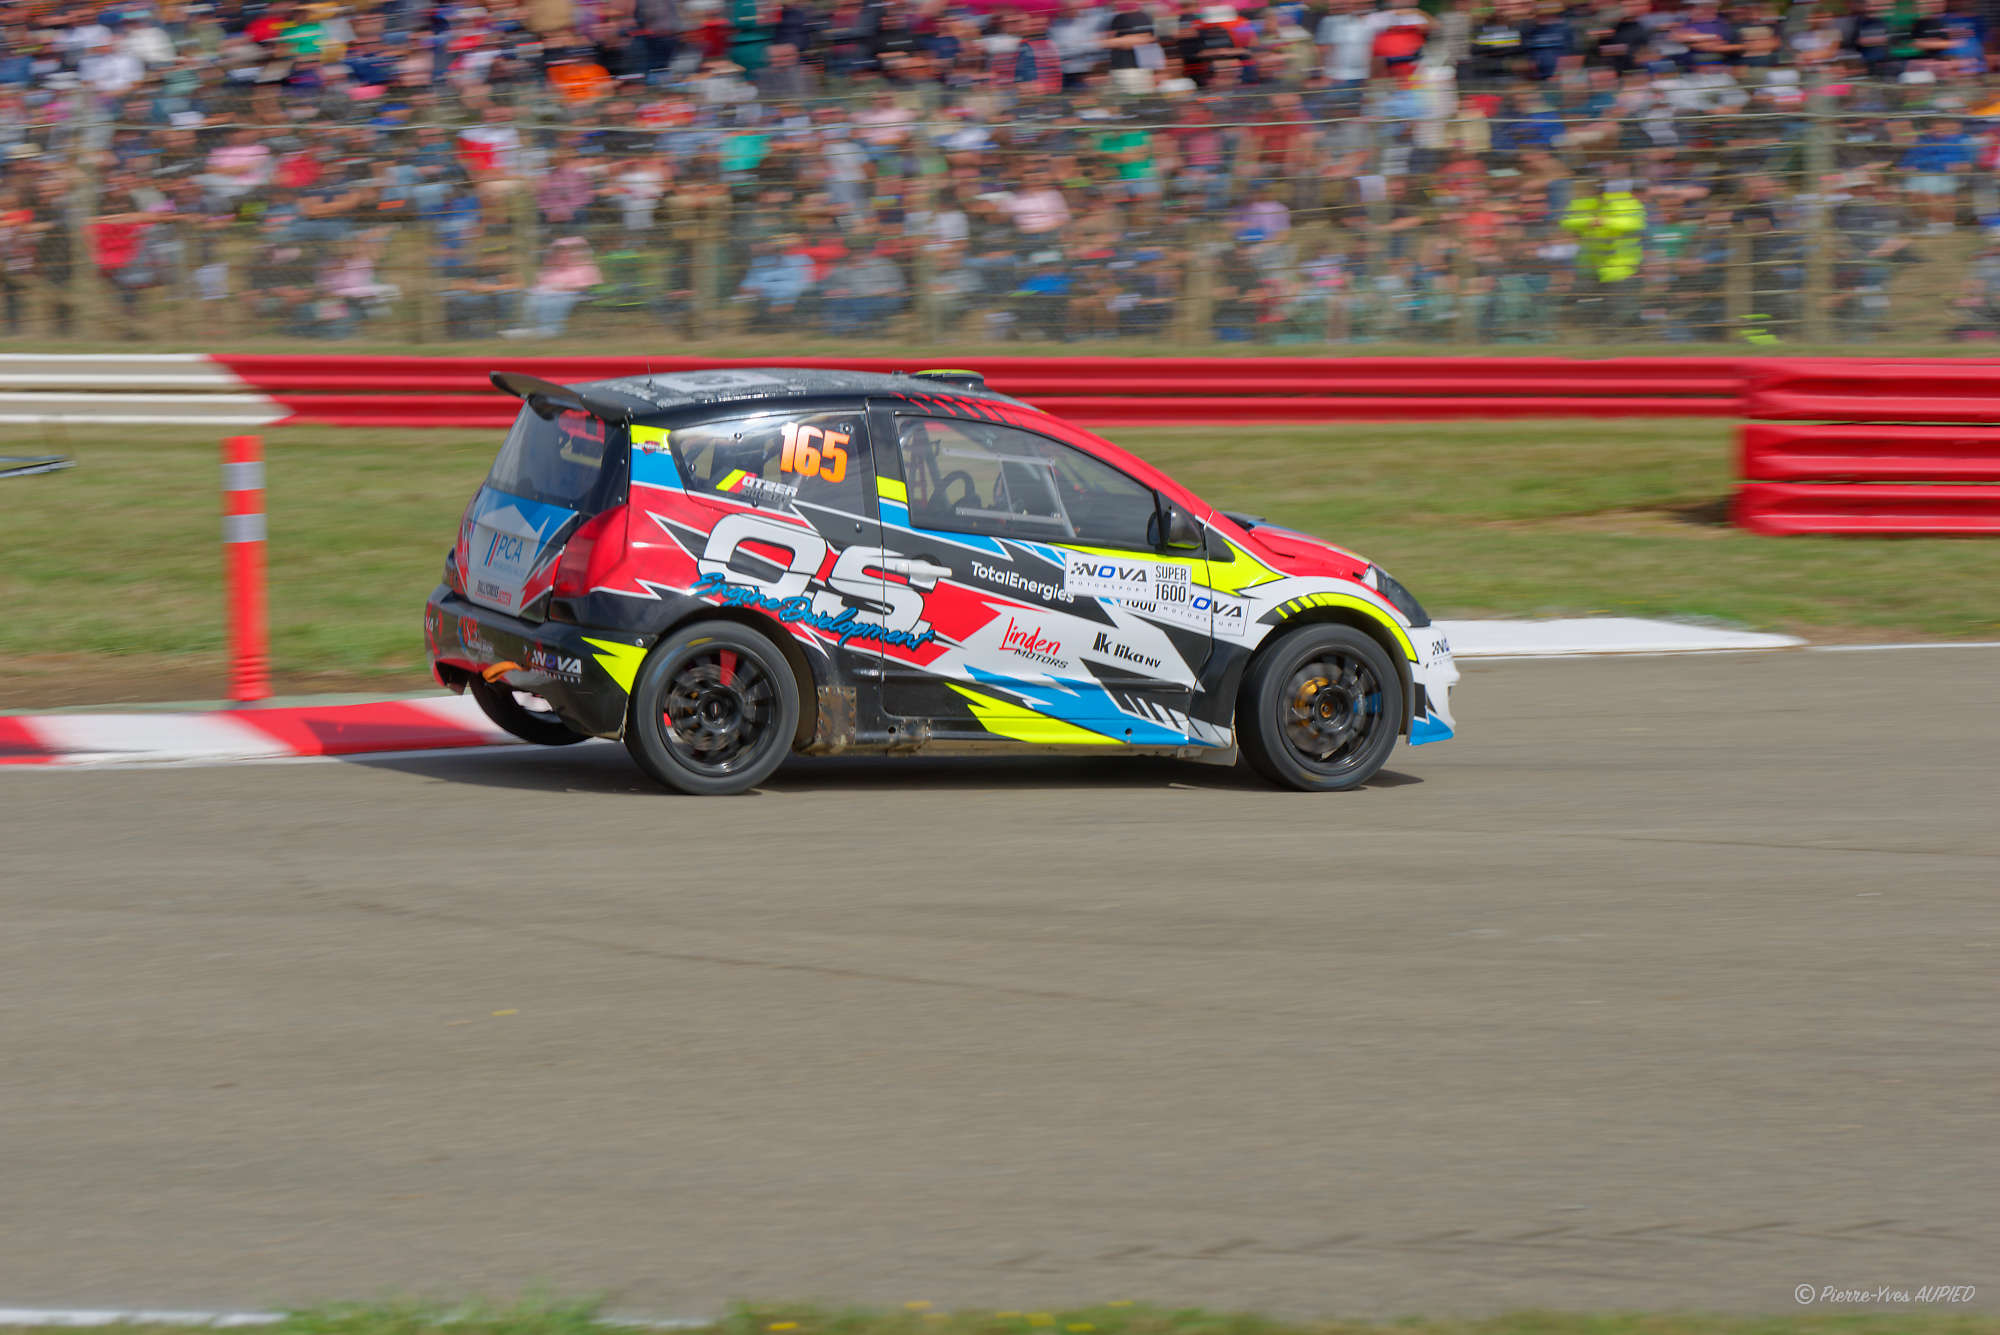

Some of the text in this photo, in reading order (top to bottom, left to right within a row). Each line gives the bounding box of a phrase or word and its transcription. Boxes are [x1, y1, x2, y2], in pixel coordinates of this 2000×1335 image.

[780, 422, 850, 483] 165
[971, 560, 1075, 604] TotalEnergies
[1075, 562, 1148, 583] NOVA
[1155, 565, 1187, 582] SUPER
[1155, 583, 1187, 604] 1600
[690, 571, 937, 652] Engine Development
[1190, 594, 1243, 618] OVA
[998, 616, 1061, 656] Linden
[532, 649, 582, 675] NOVA
[1014, 648, 1069, 669] MOTORS
[1145, 656, 1161, 668] NV
